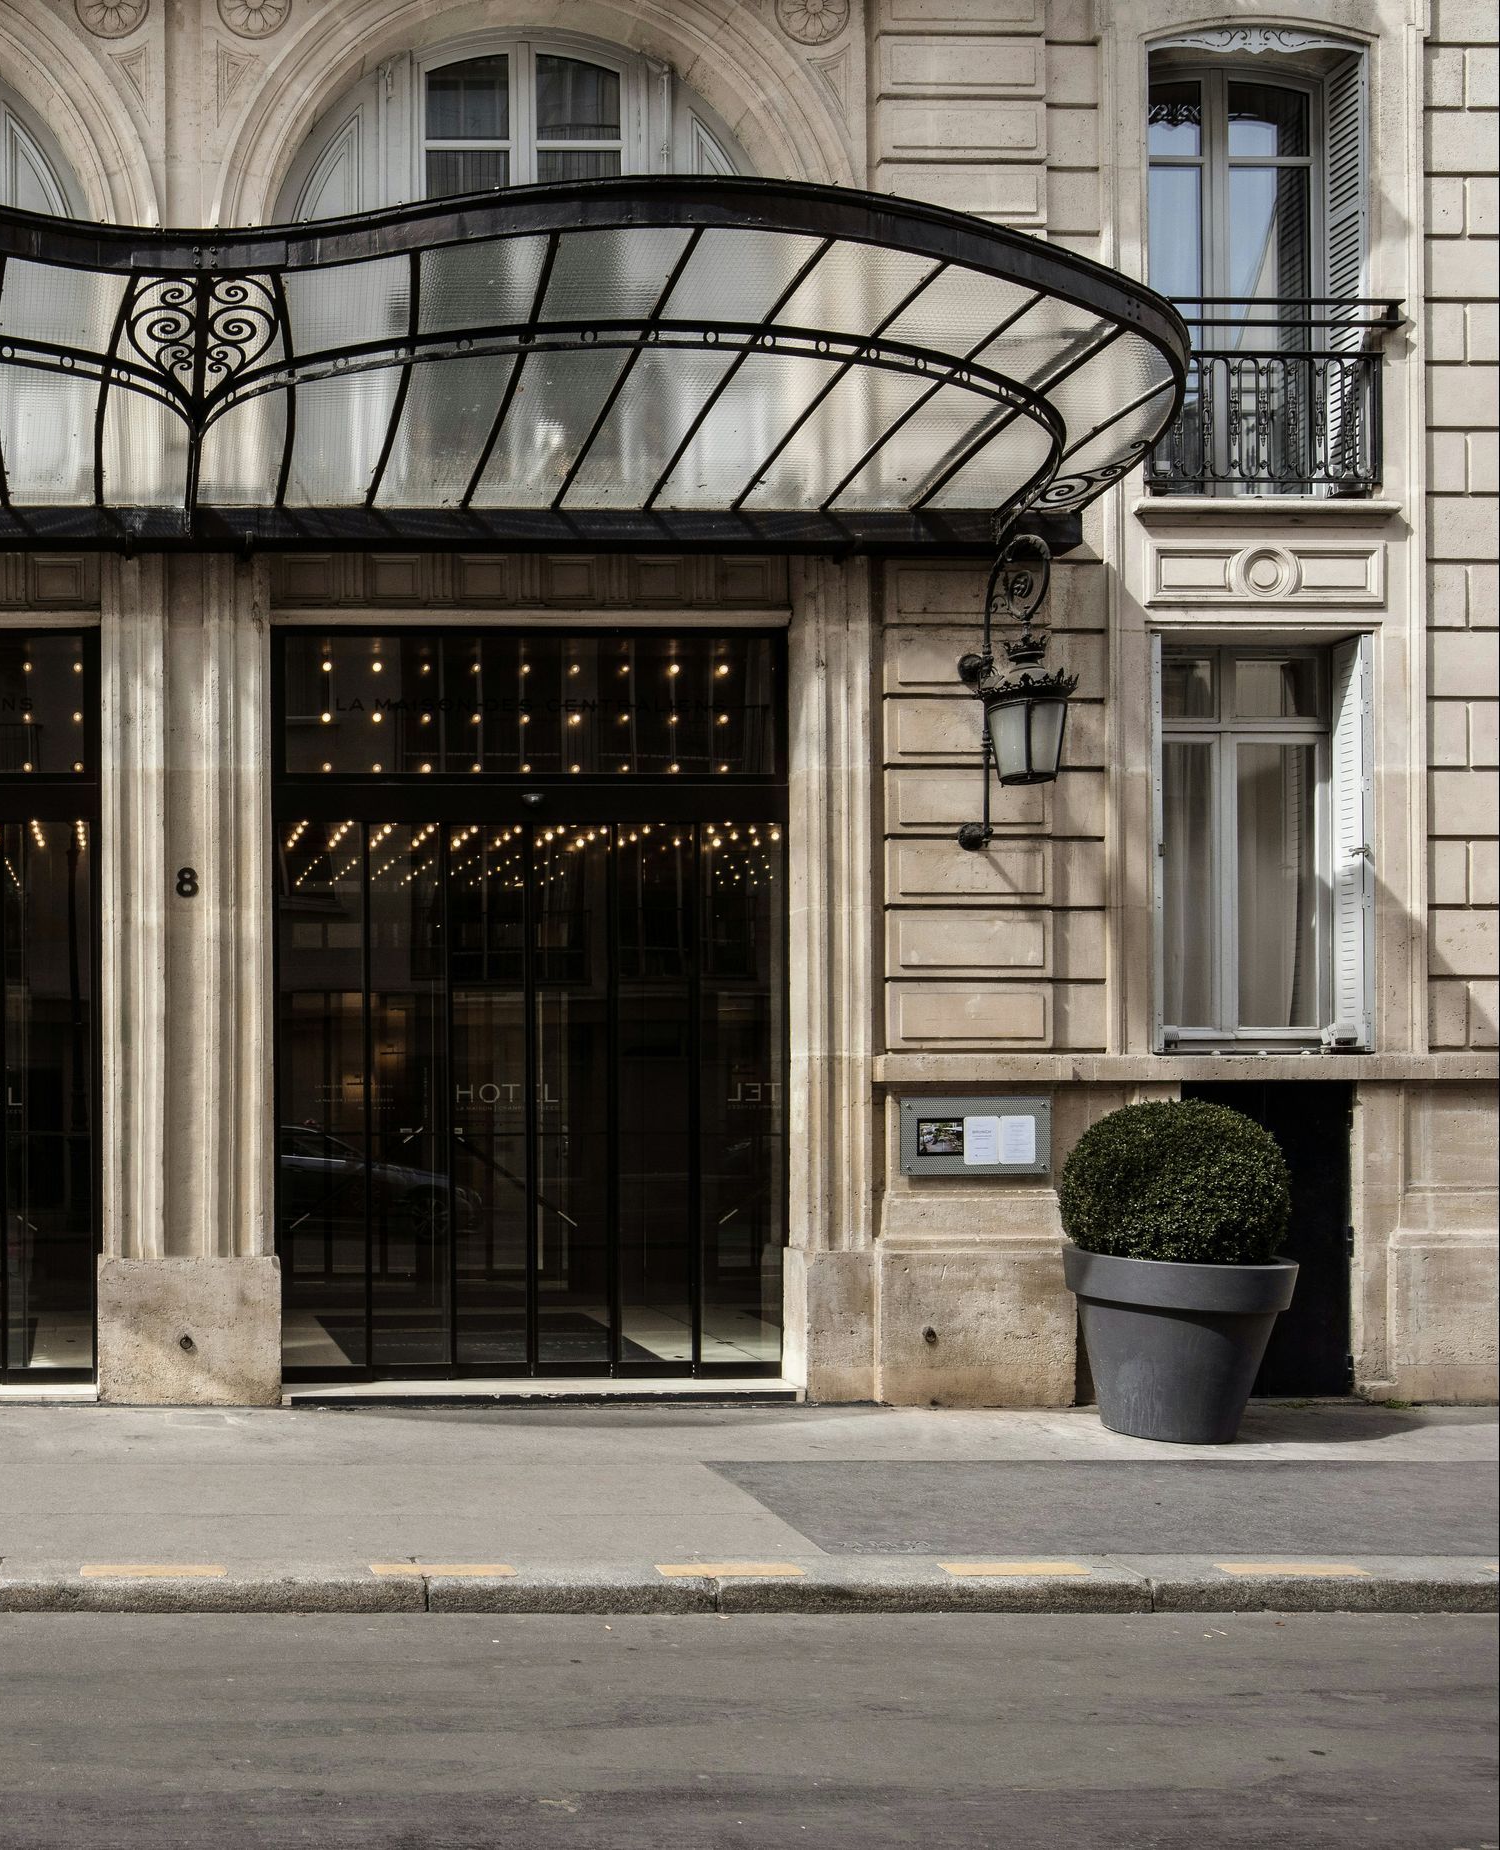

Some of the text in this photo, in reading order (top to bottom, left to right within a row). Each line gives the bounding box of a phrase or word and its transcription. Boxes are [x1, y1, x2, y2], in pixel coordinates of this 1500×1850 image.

[335, 698, 365, 712] LA
[374, 698, 471, 713] MAISON
[483, 698, 533, 713] DES
[176, 867, 199, 898] 8
